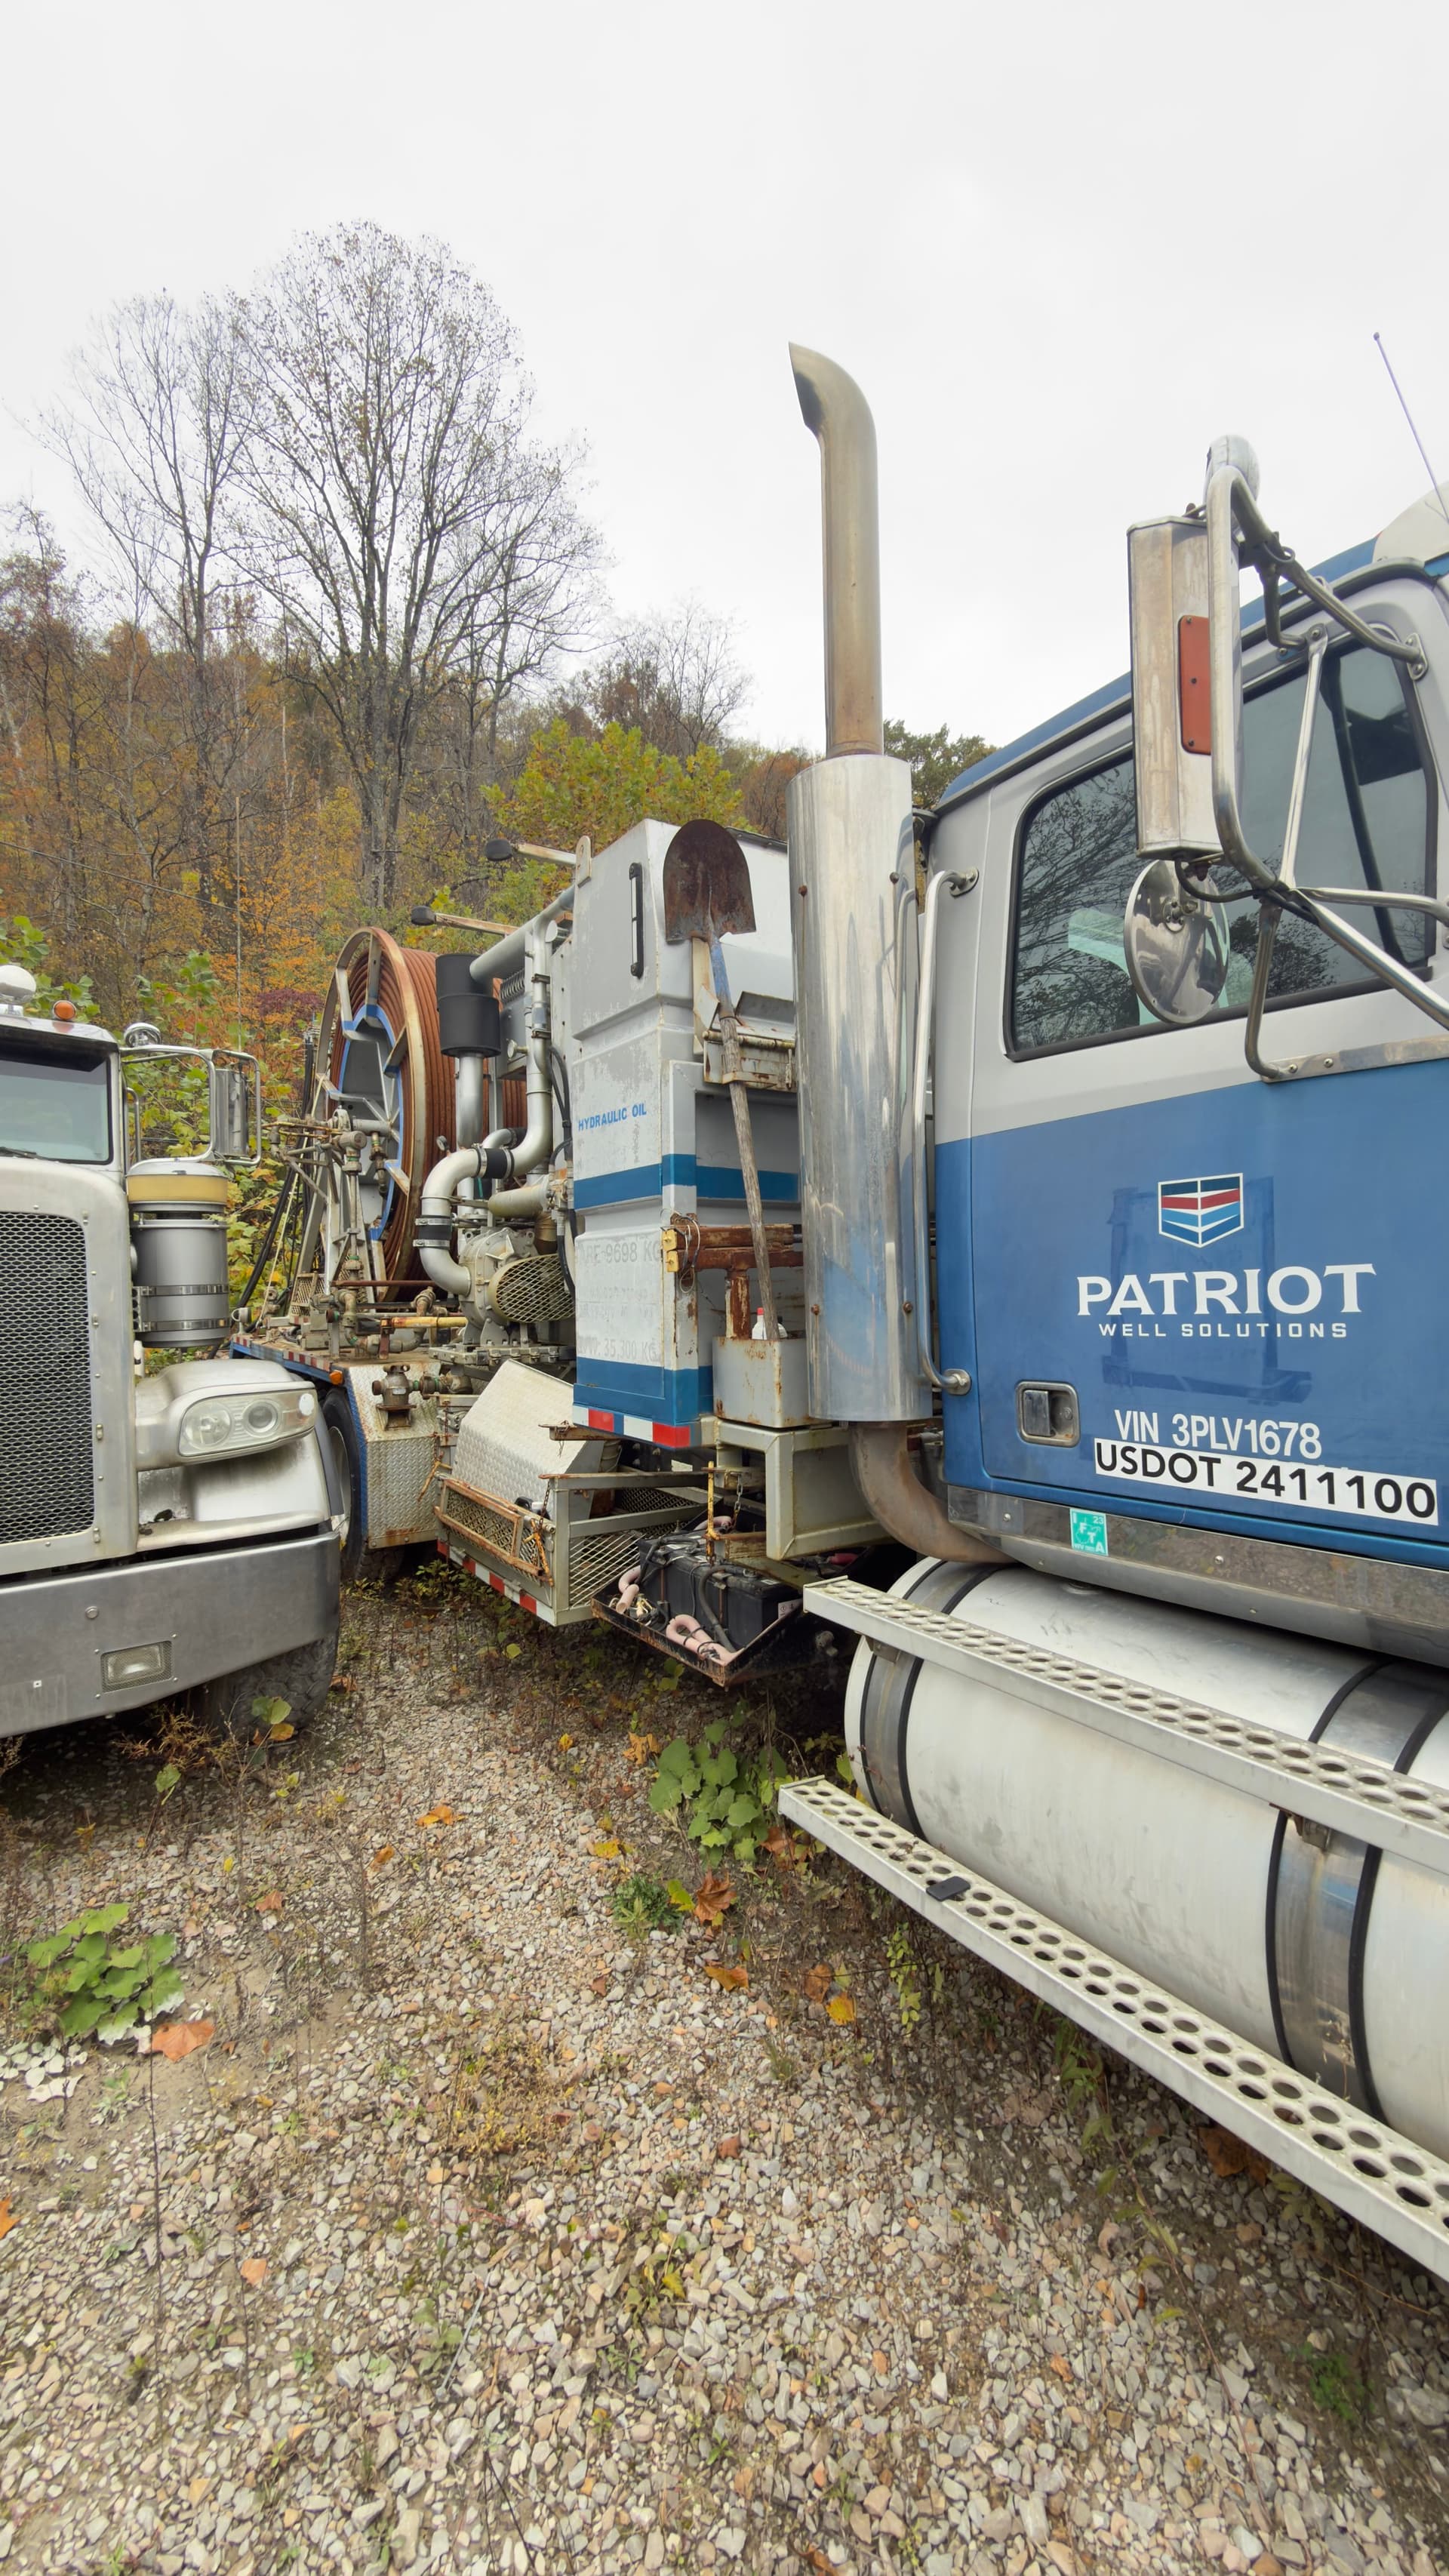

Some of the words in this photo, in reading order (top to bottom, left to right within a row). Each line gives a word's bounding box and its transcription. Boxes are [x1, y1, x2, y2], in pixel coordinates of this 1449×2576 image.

[578, 1107, 628, 1131] HYDRAULIC
[632, 1103, 648, 1118] OIL
[1076, 1263, 1377, 1316] PATRIOT
[1098, 1323, 1167, 1337] WELL
[1181, 1322, 1347, 1338] SOLUTIONS
[1113, 1408, 1159, 1444] VIN
[1171, 1413, 1322, 1460] 3PLV1678
[1096, 1442, 1221, 1487] USDOT
[1236, 1460, 1435, 1519] 2411100
[1093, 1516, 1104, 1525] 23
